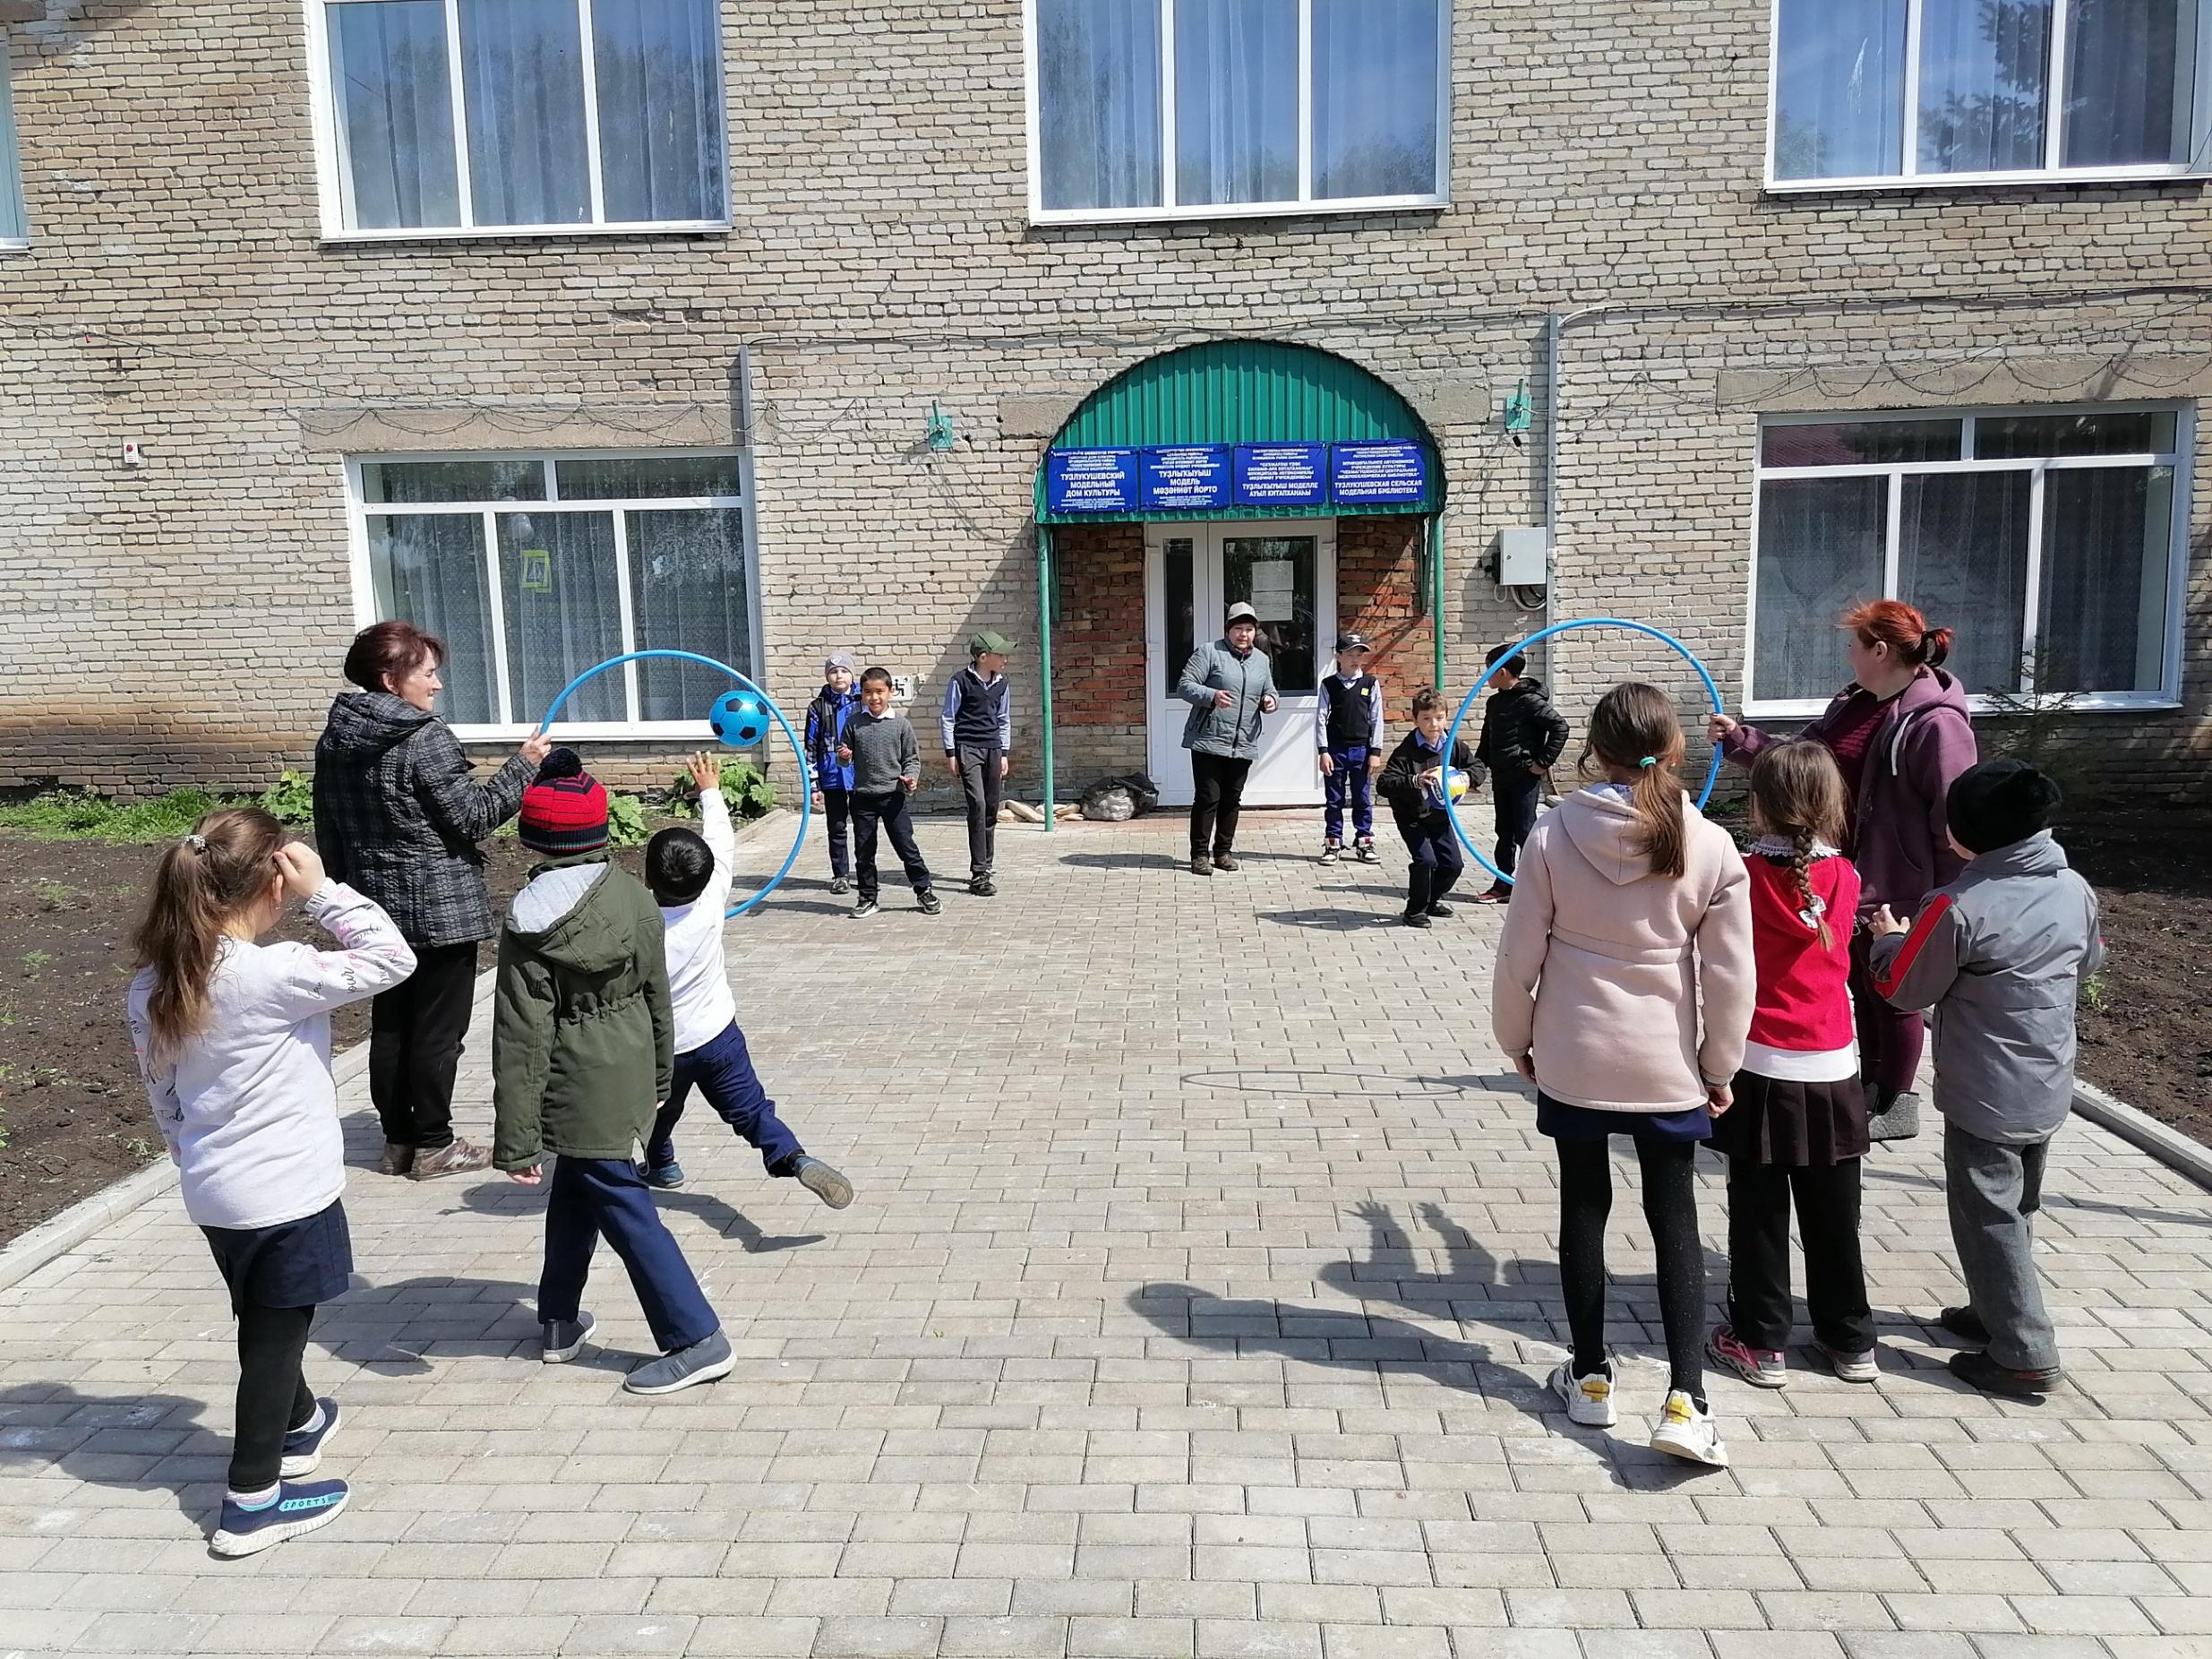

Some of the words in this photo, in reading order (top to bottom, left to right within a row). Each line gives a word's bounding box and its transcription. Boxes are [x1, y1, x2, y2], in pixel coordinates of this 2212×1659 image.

[1060, 470, 1125, 481] ТУЗЛУКУШЕВСКИЙ
[1070, 479, 1116, 489] МОДЕЛЬНЫЙ
[1170, 477, 1201, 486] МОДЕЛЬ
[1334, 481, 1390, 489] ТУЗЛУКУШЕВСКАЯ
[1066, 489, 1083, 498] ДОМ
[1084, 488, 1120, 497] КУЛЬТУРЫ
[1194, 485, 1218, 494] ЙОРТО
[1339, 487, 1377, 496] МОДЕЛЬНАЯ
[1377, 486, 1418, 494] БИБЛИОТЕКА
[284, 1498, 326, 1509] SPORTS
